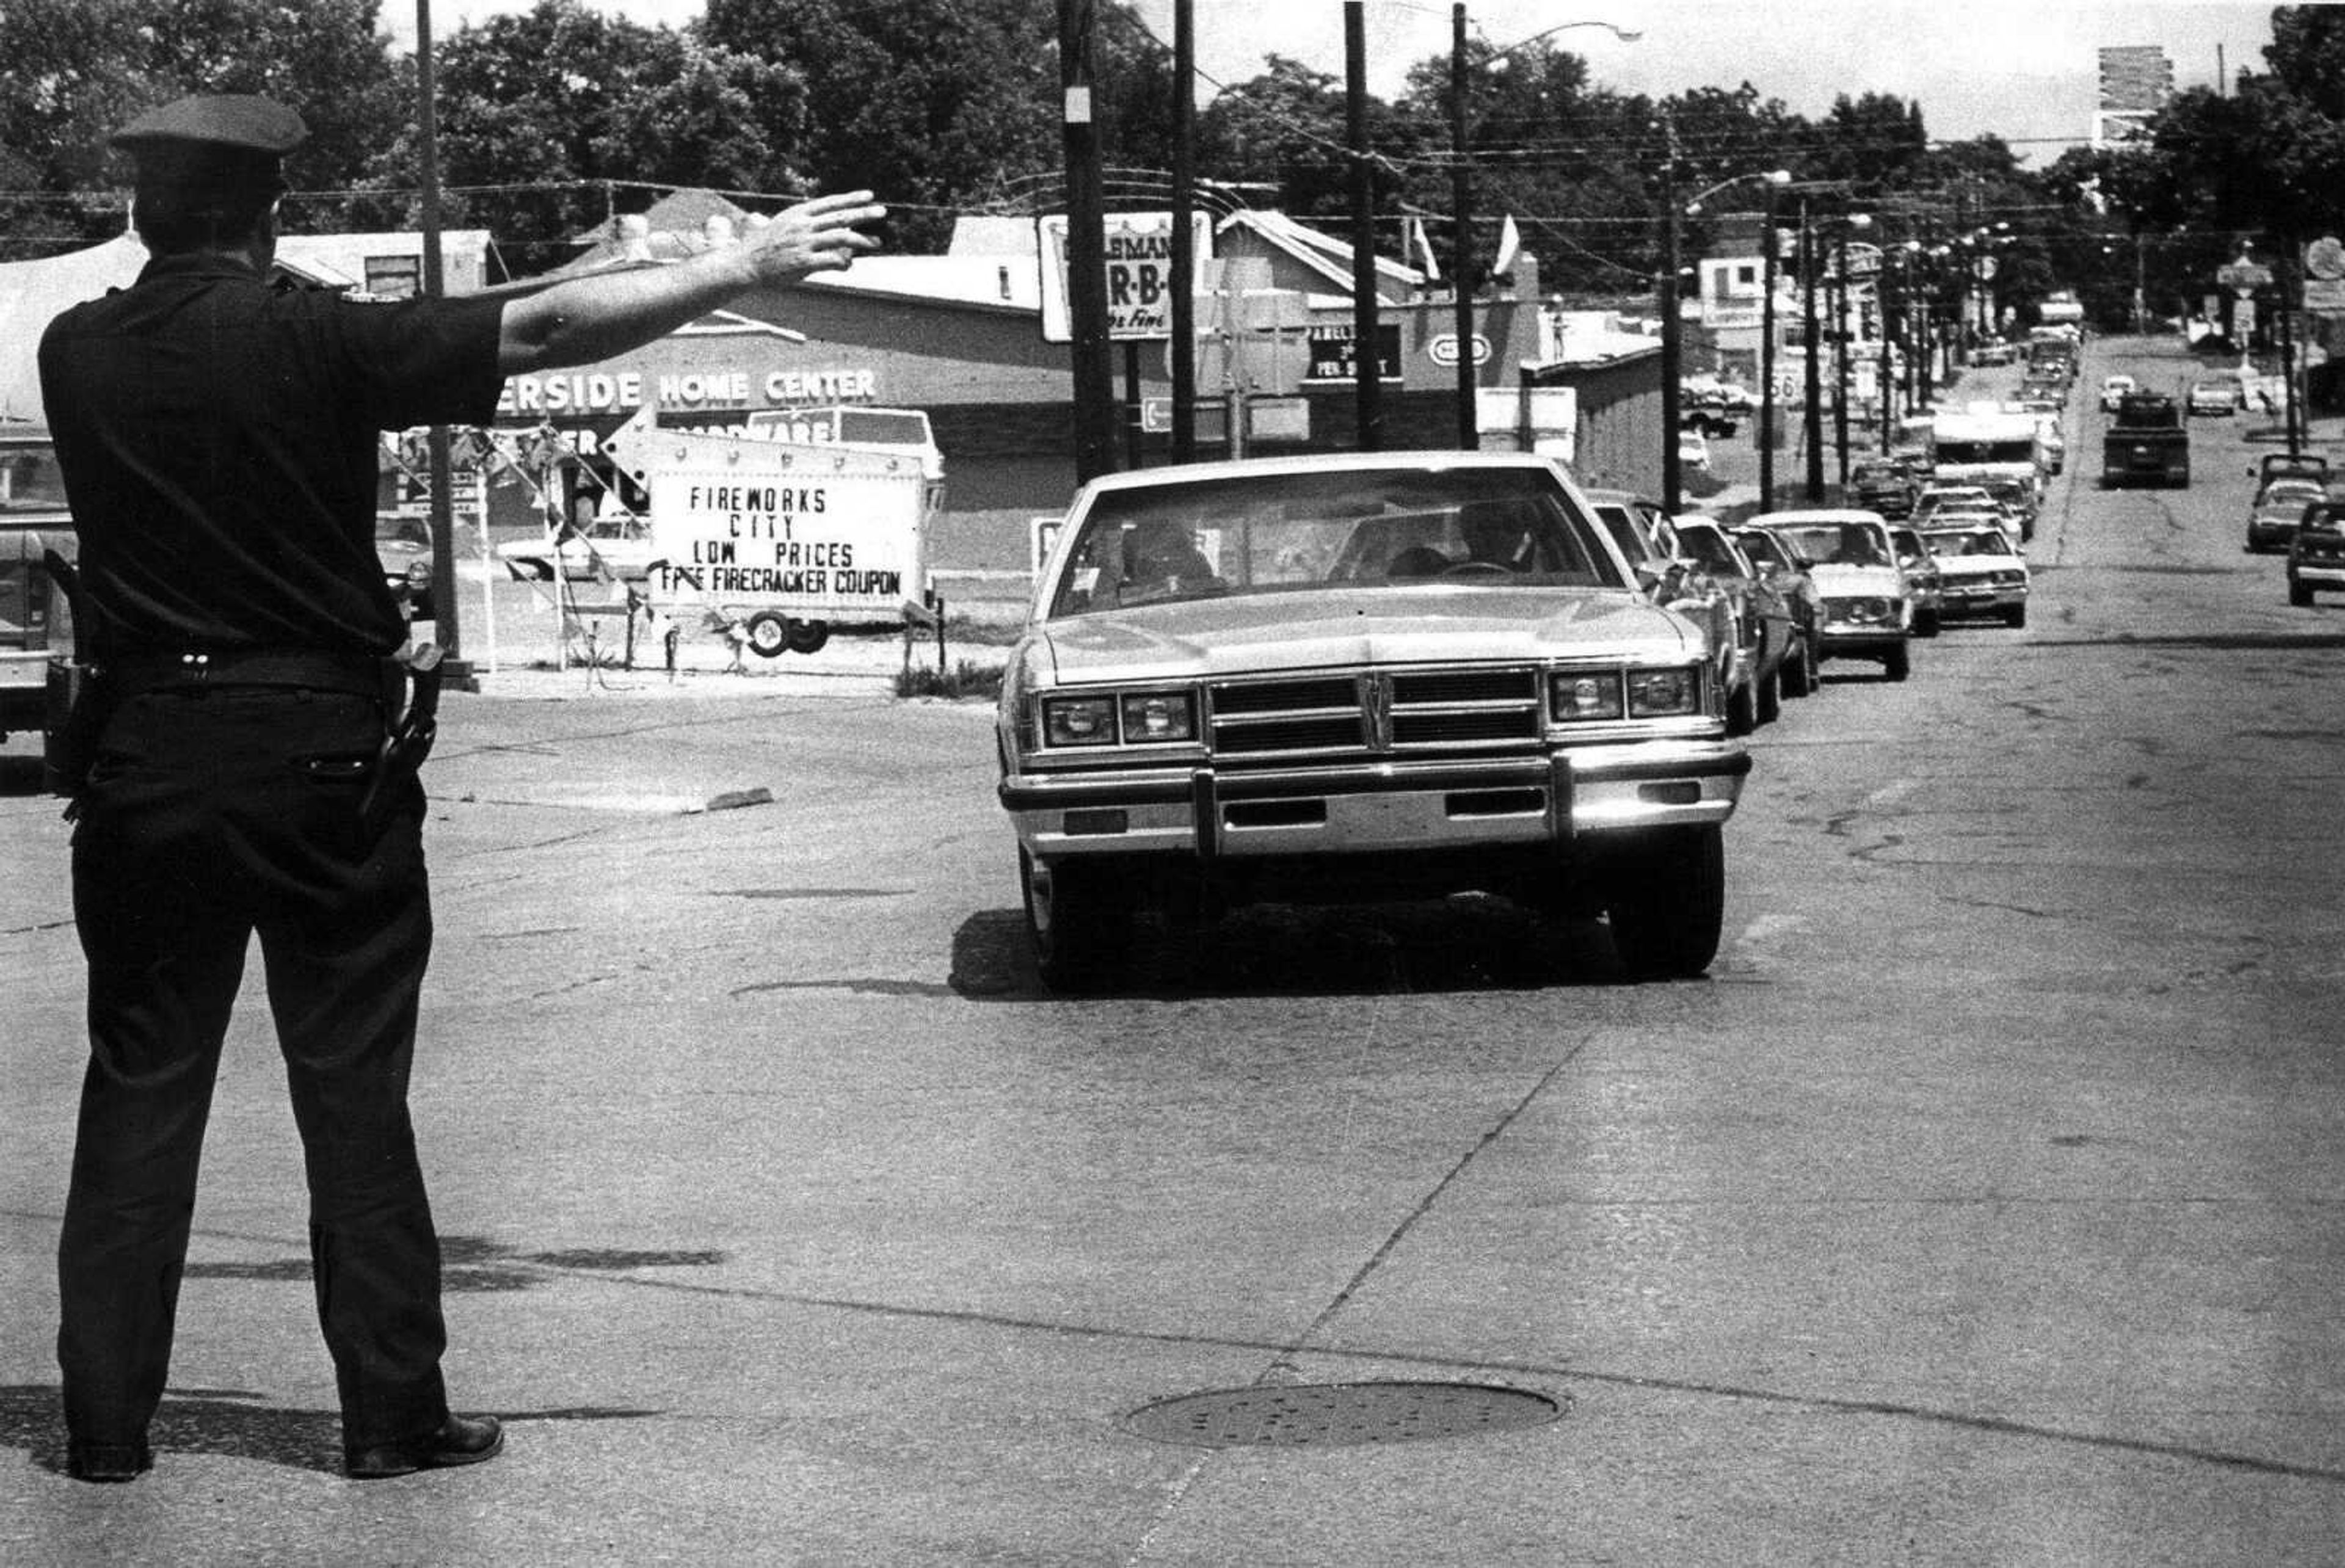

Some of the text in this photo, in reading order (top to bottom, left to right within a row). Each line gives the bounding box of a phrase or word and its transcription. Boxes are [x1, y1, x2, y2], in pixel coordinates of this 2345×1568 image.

[659, 374, 748, 401] HOME
[765, 370, 876, 398] CENTER
[691, 487, 826, 512] FIREWORKS
[730, 514, 793, 539] CITY
[693, 541, 853, 567] LOW PRICES
[662, 565, 900, 595] FRE FIRECRACKER COUPON
